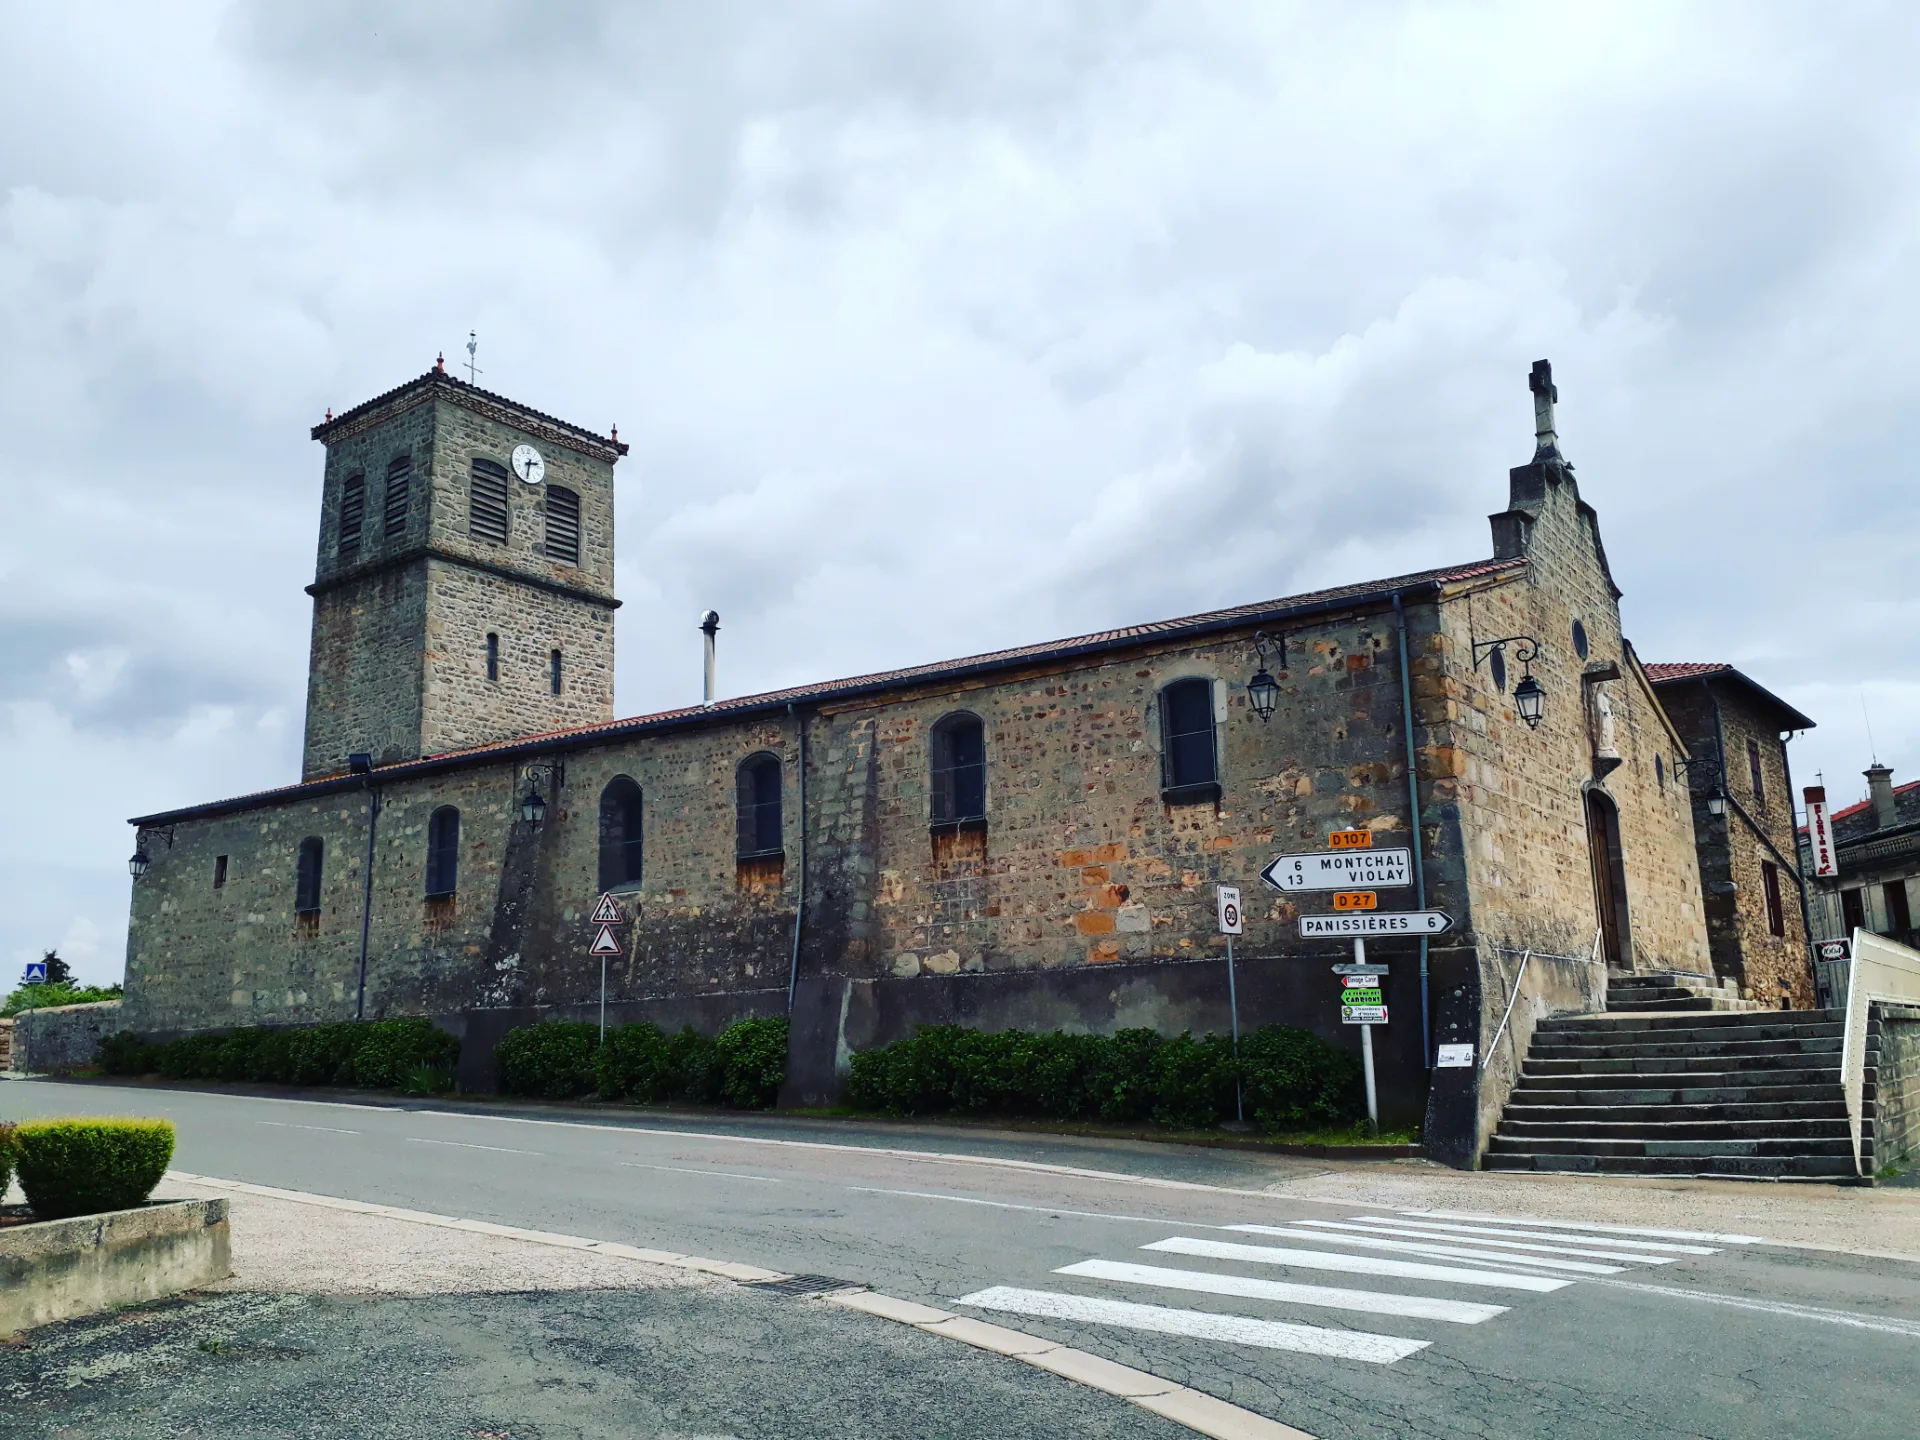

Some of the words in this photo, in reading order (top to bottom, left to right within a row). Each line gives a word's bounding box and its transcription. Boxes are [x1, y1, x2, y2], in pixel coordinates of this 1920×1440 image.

[1294, 860, 1302, 871] 6
[1320, 855, 1404, 870] MONTCHAL
[1819, 848, 1829, 864] BAR
[1287, 874, 1303, 885] 13
[1348, 869, 1404, 882] VIOLAY
[1223, 892, 1236, 900] ZONE
[1339, 896, 1347, 906] D
[1352, 895, 1371, 906] 27
[1227, 910, 1235, 920] 30
[1306, 916, 1408, 932] PANISSIÈRES
[1427, 916, 1436, 928] 6
